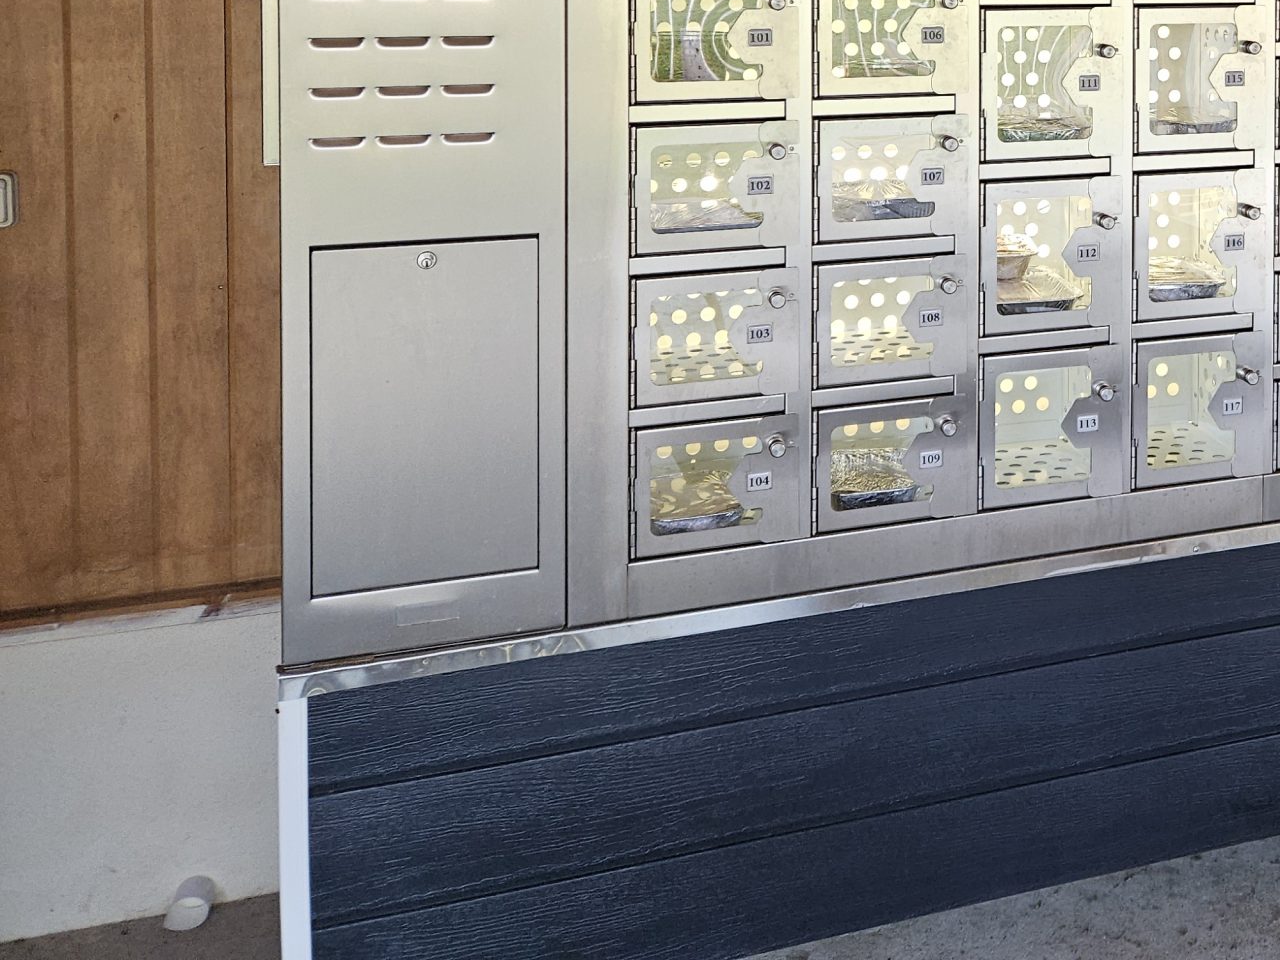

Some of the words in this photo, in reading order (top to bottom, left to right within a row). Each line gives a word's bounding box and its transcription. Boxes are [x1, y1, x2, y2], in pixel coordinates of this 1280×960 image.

[750, 31, 771, 43] 101
[922, 29, 942, 41] 106
[1081, 78, 1099, 88] 111
[1226, 74, 1243, 84] 115
[921, 171, 943, 182] 107
[750, 179, 771, 191] 102
[1225, 238, 1243, 248] 116
[1078, 247, 1097, 258] 112
[921, 312, 941, 324] 108
[749, 328, 770, 340] 103
[1223, 402, 1241, 412] 117
[1078, 418, 1097, 429] 113
[921, 453, 941, 465] 109
[749, 476, 770, 488] 104
